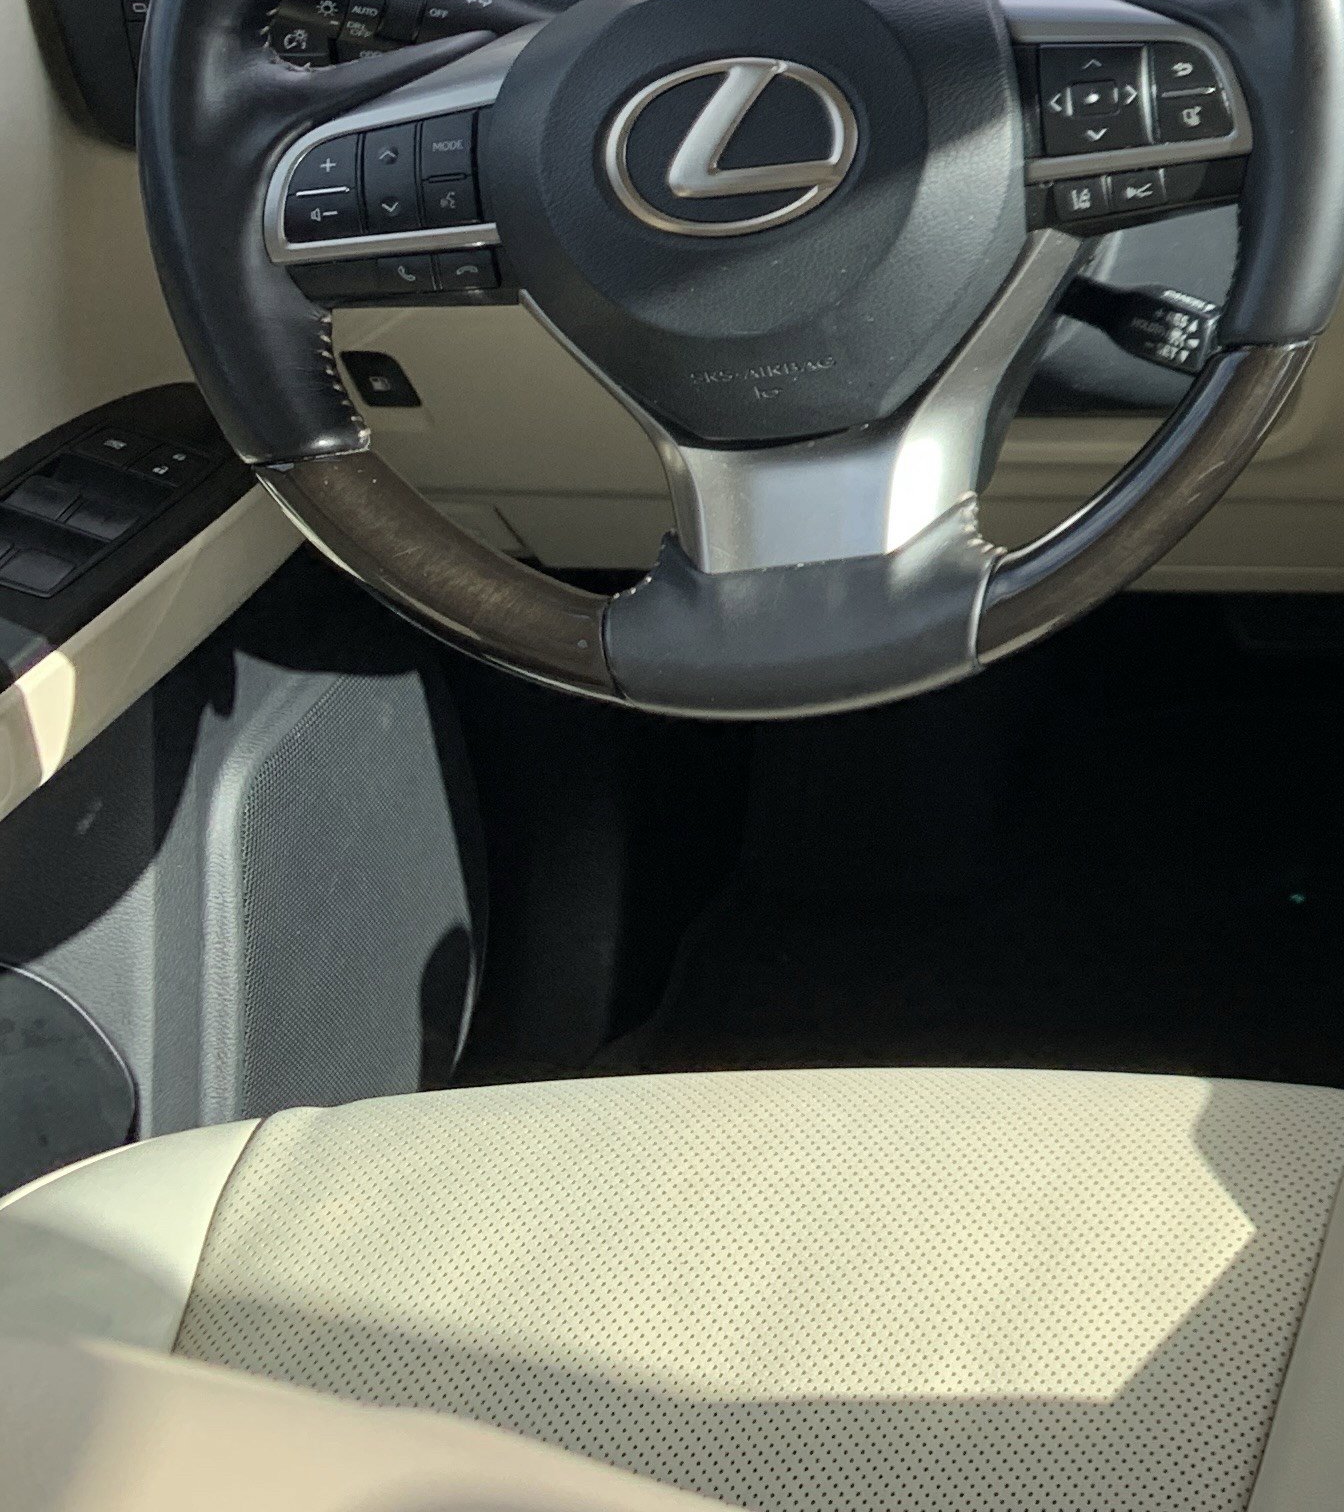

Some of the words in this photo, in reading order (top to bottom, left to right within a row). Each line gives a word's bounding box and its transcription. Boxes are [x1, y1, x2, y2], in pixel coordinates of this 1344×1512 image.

[351, 5, 379, 17] AUTO
[429, 8, 449, 19] OFF
[432, 139, 464, 152] MODE
